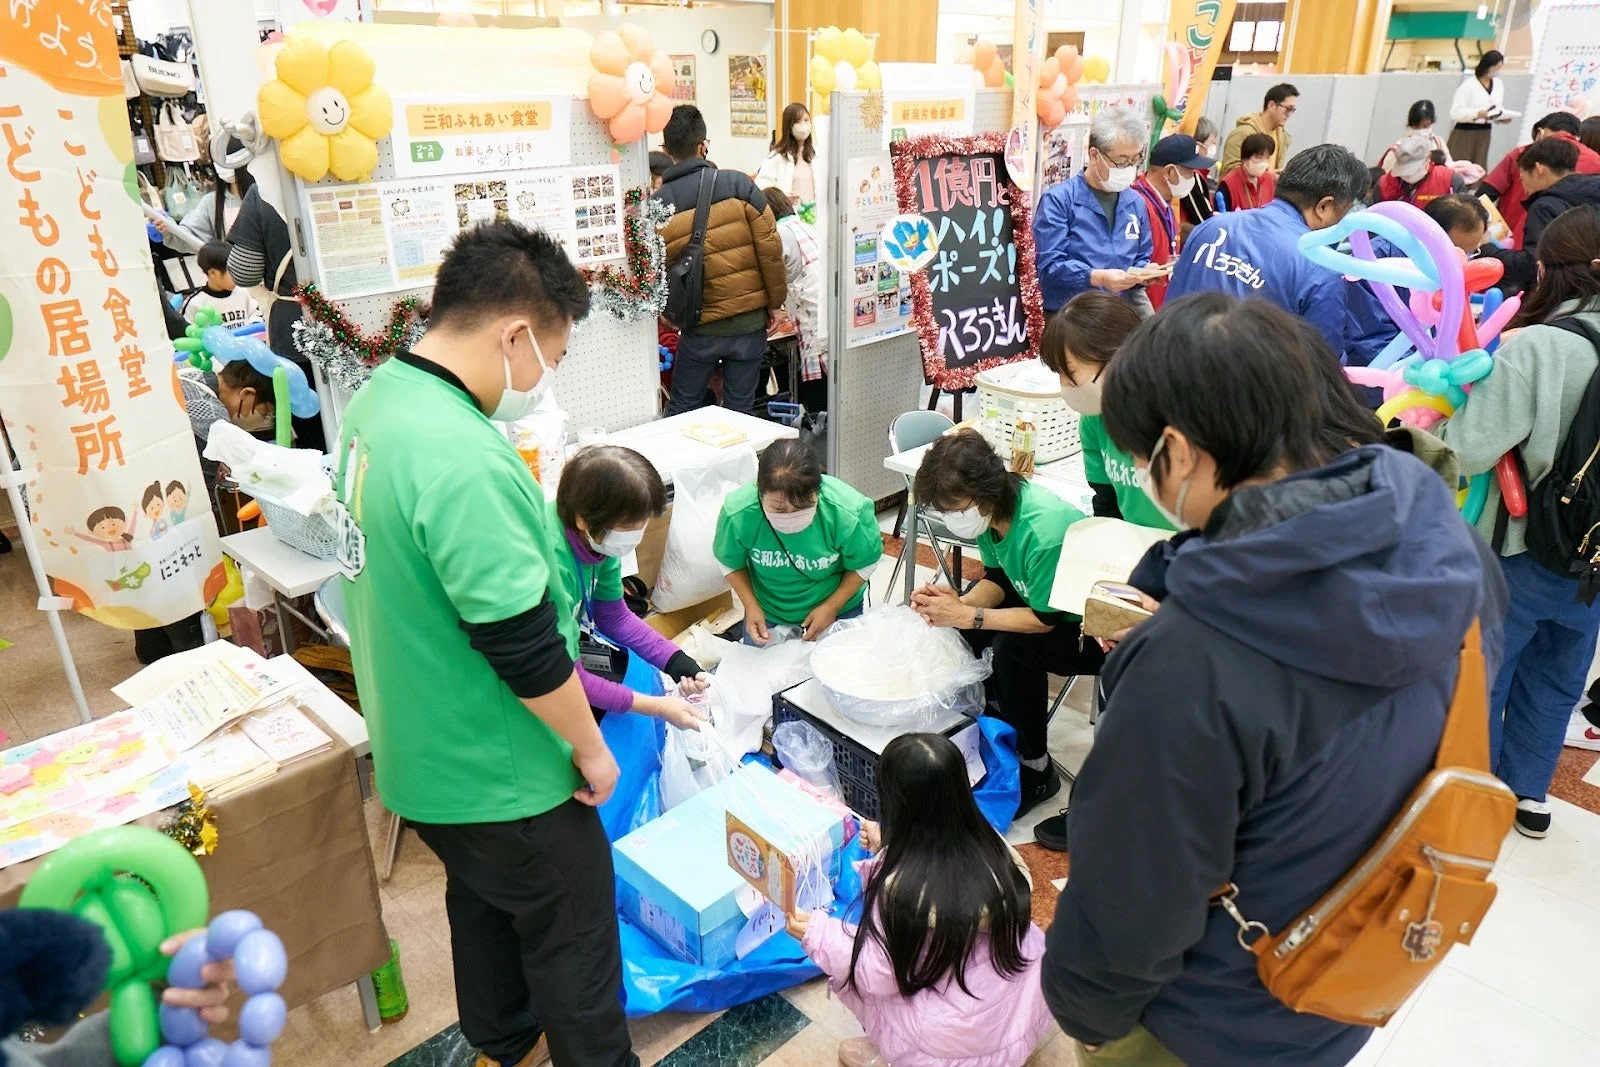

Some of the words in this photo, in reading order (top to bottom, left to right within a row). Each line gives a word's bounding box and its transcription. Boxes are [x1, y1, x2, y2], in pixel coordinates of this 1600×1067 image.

[423, 110, 539, 130] 三和ふれあい食堂
[455, 143, 533, 157] お楽しみくじ引き
[915, 157, 1010, 213] 1億円と
[938, 208, 1005, 247] ハイ!
[57, 108, 152, 399] こども食堂
[929, 242, 1018, 292] ポーズ!
[1214, 252, 1266, 289] ろうきん
[959, 296, 1029, 352] ろうきん
